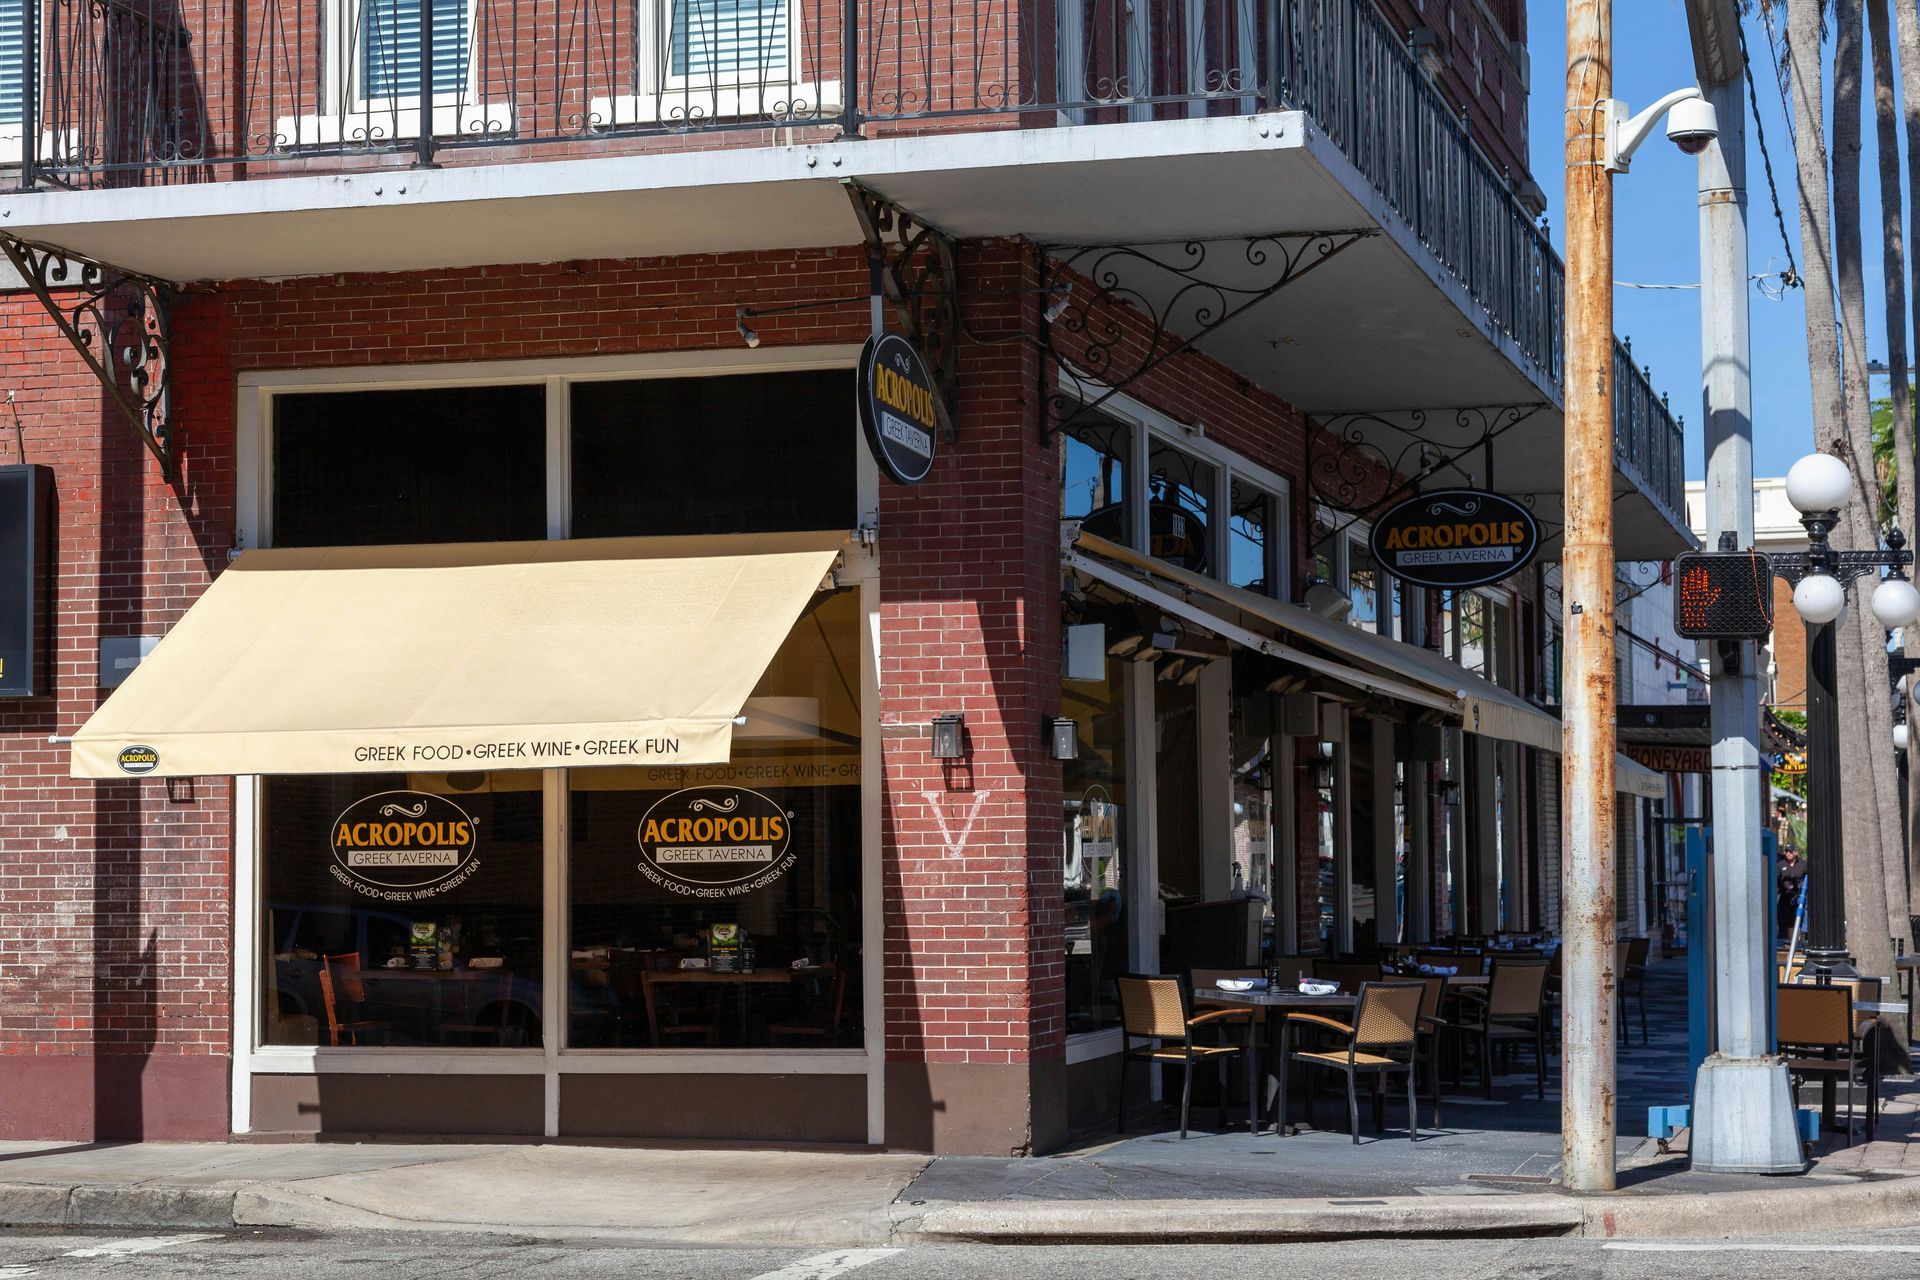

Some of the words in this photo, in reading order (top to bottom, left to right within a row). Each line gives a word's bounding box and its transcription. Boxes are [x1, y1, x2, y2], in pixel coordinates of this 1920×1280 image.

[876, 362, 934, 428] ACROPOLIS
[887, 416, 903, 440] GREEK
[904, 426, 929, 455] TAVERNA
[1385, 521, 1525, 549] ACROPOLIS
[1402, 550, 1445, 564] GREEK
[1446, 549, 1507, 562] TAVERNA
[121, 754, 156, 762] ACROPOLIS
[354, 746, 406, 762] GREEK
[645, 738, 679, 754] FUN
[648, 767, 689, 781] GREEK
[336, 821, 470, 847] ACROPOLIS
[643, 816, 783, 843] ACROPOLIS
[353, 852, 393, 864] GREEK
[397, 852, 451, 864] TAVERNA
[662, 848, 704, 861] GREEK
[708, 848, 766, 860] TAVERNA
[329, 864, 354, 888] GREEK
[465, 858, 481, 876] FUN
[637, 862, 663, 886] GREEK
[782, 852, 798, 871] FUN
